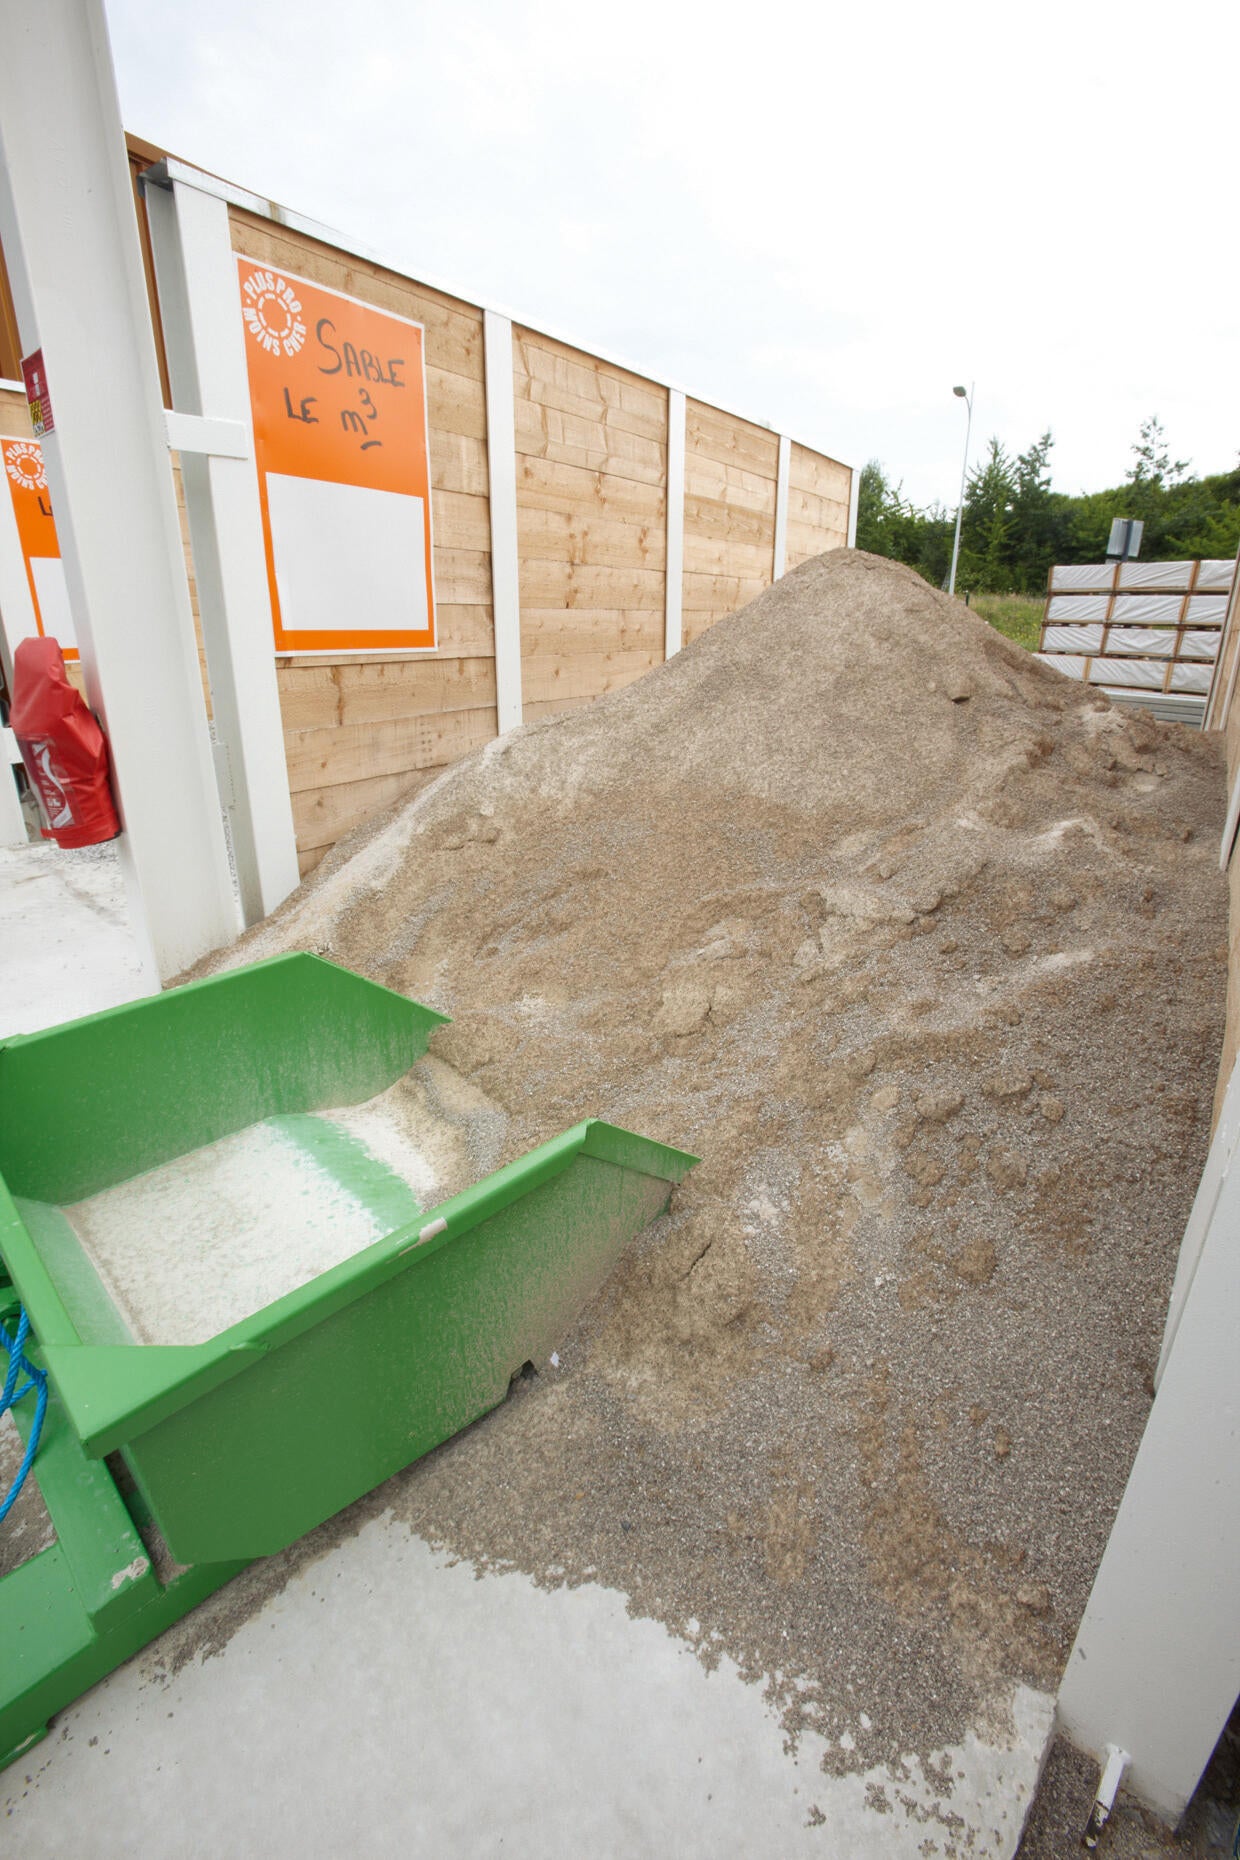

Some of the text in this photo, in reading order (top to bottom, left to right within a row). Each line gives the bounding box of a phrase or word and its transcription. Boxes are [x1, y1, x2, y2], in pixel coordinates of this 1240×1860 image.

[243, 272, 302, 313] PLUS PRO
[242, 307, 307, 357] MOINS CHER
[316, 318, 405, 387] SABLE
[283, 387, 319, 423] LE
[6, 443, 45, 464] PLUS PR
[6, 465, 35, 490] MOINS
[38, 496, 53, 516] L
